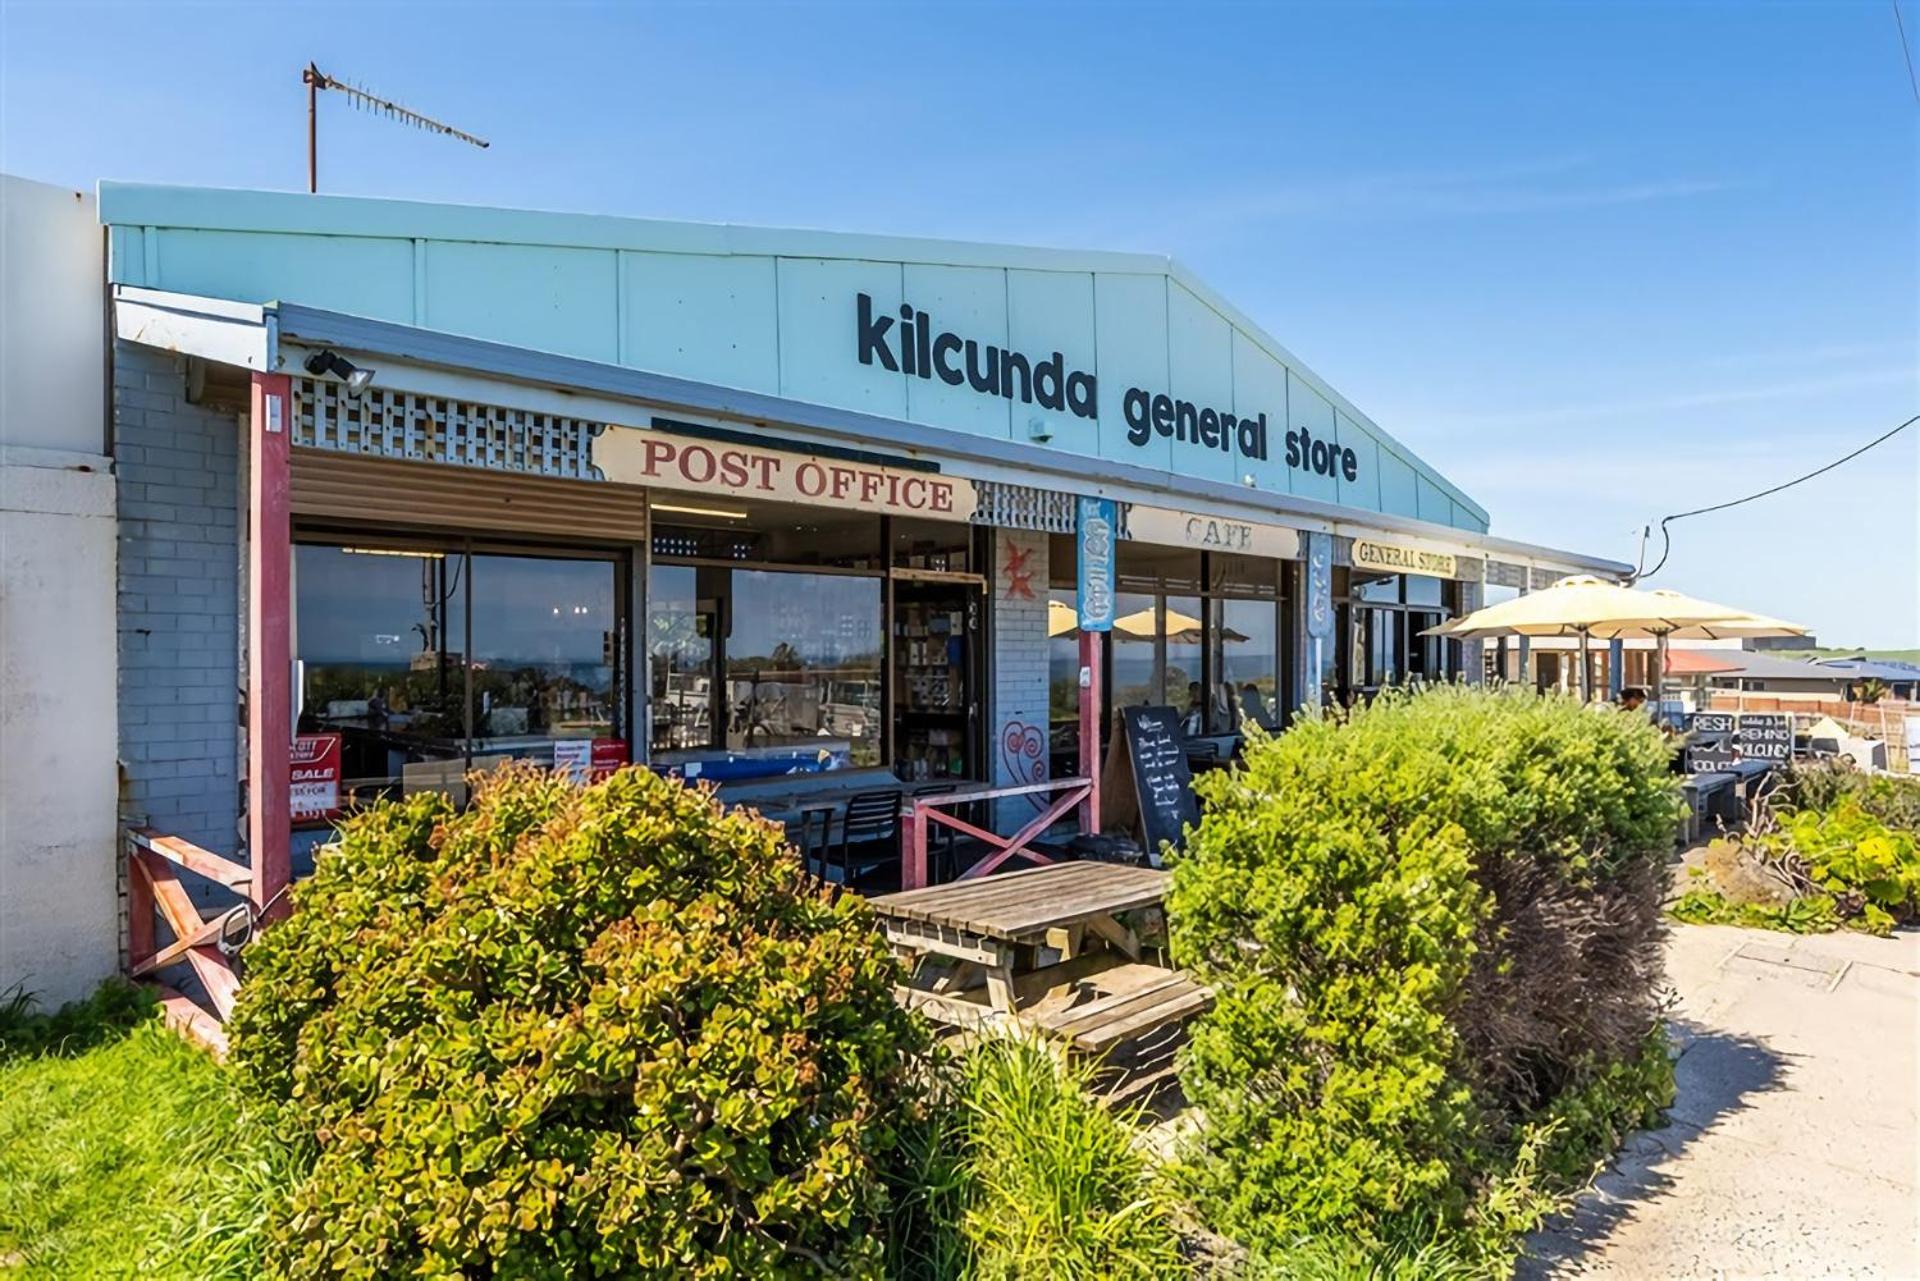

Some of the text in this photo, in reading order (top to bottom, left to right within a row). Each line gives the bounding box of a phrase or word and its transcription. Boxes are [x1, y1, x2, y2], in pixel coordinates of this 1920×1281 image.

[857, 292, 1357, 482] kilcunda general store
[640, 439, 953, 513] POST OFFICE
[1185, 517, 1253, 550] CAFE
[1359, 542, 1416, 568] GENERAL
[292, 767, 335, 780] SALE
